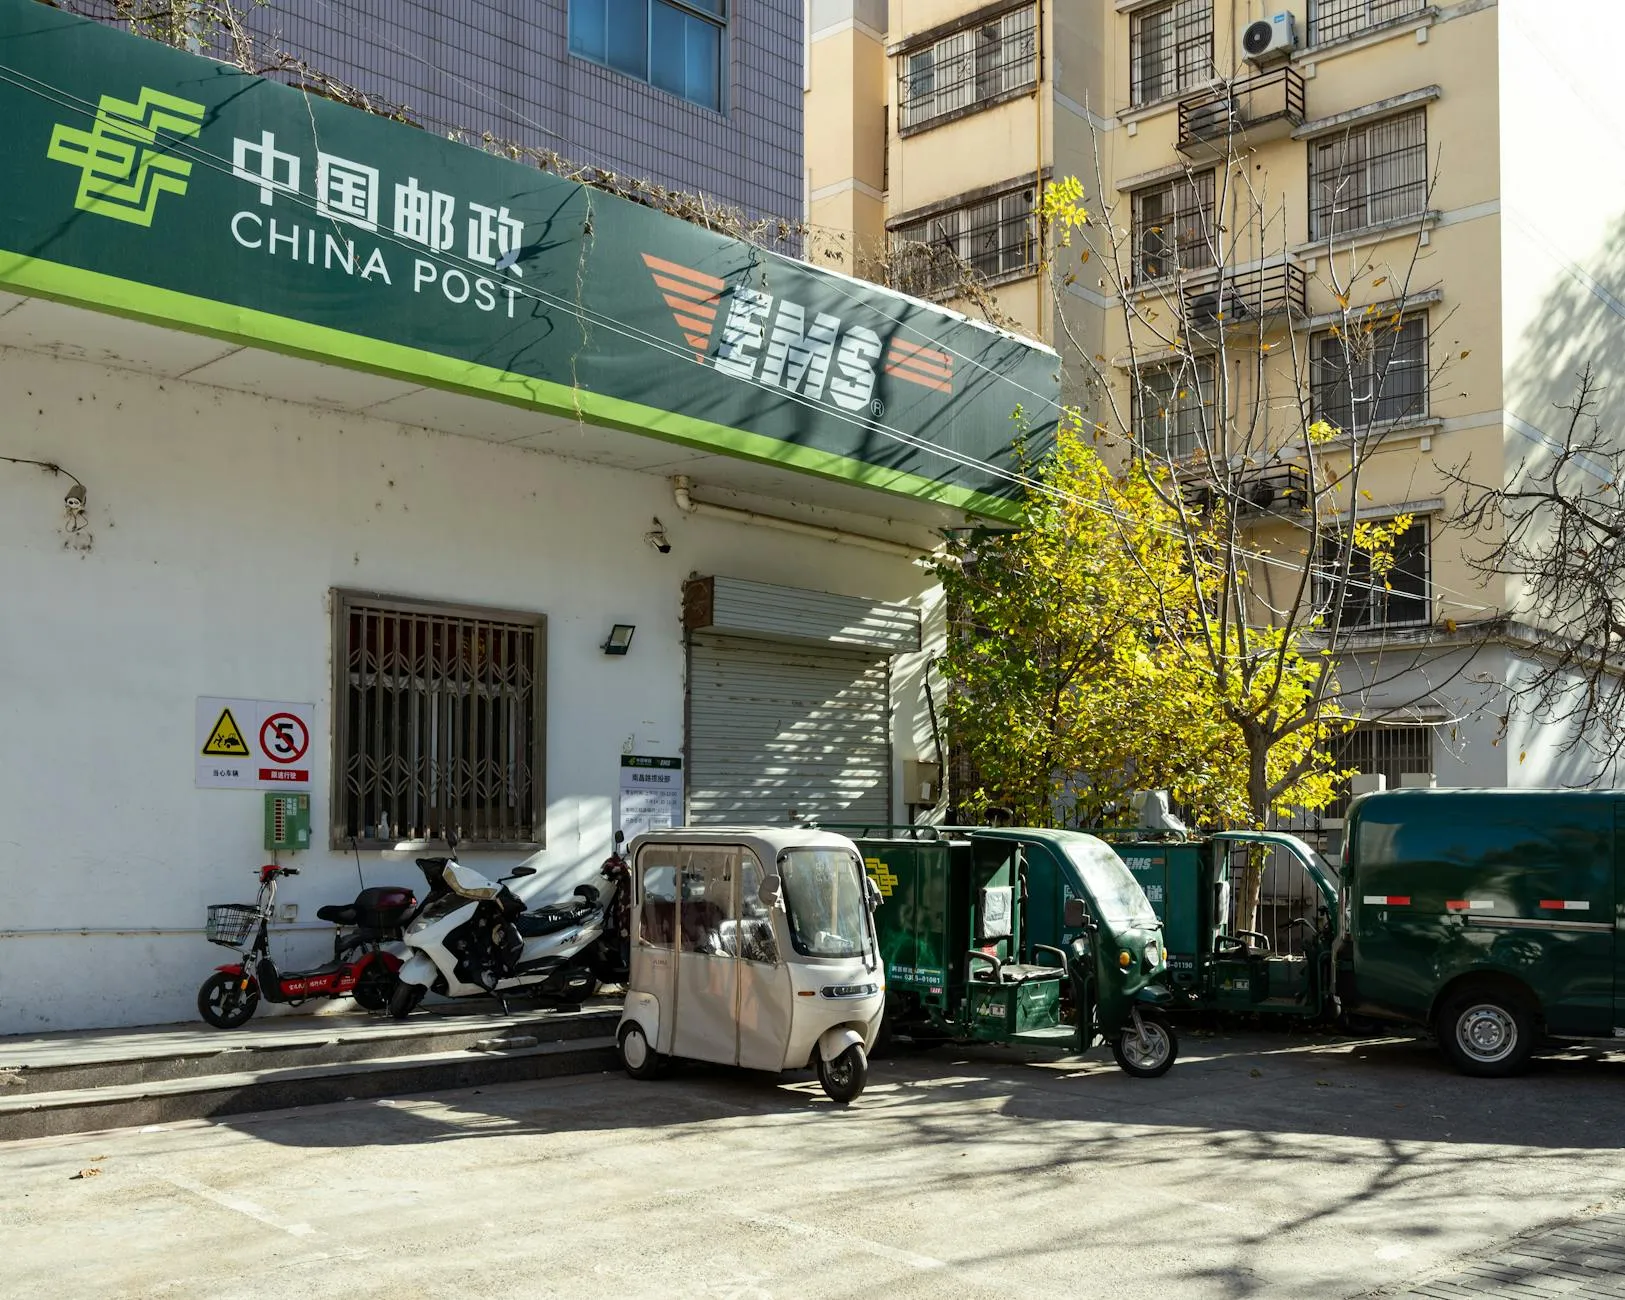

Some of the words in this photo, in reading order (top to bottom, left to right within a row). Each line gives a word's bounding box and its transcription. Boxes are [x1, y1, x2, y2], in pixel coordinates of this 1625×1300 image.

[233, 130, 525, 278] 中国邮政
[231, 211, 392, 285] CHINA
[414, 258, 522, 318] POST
[714, 284, 883, 412] EMS
[1126, 857, 1152, 870] EMS
